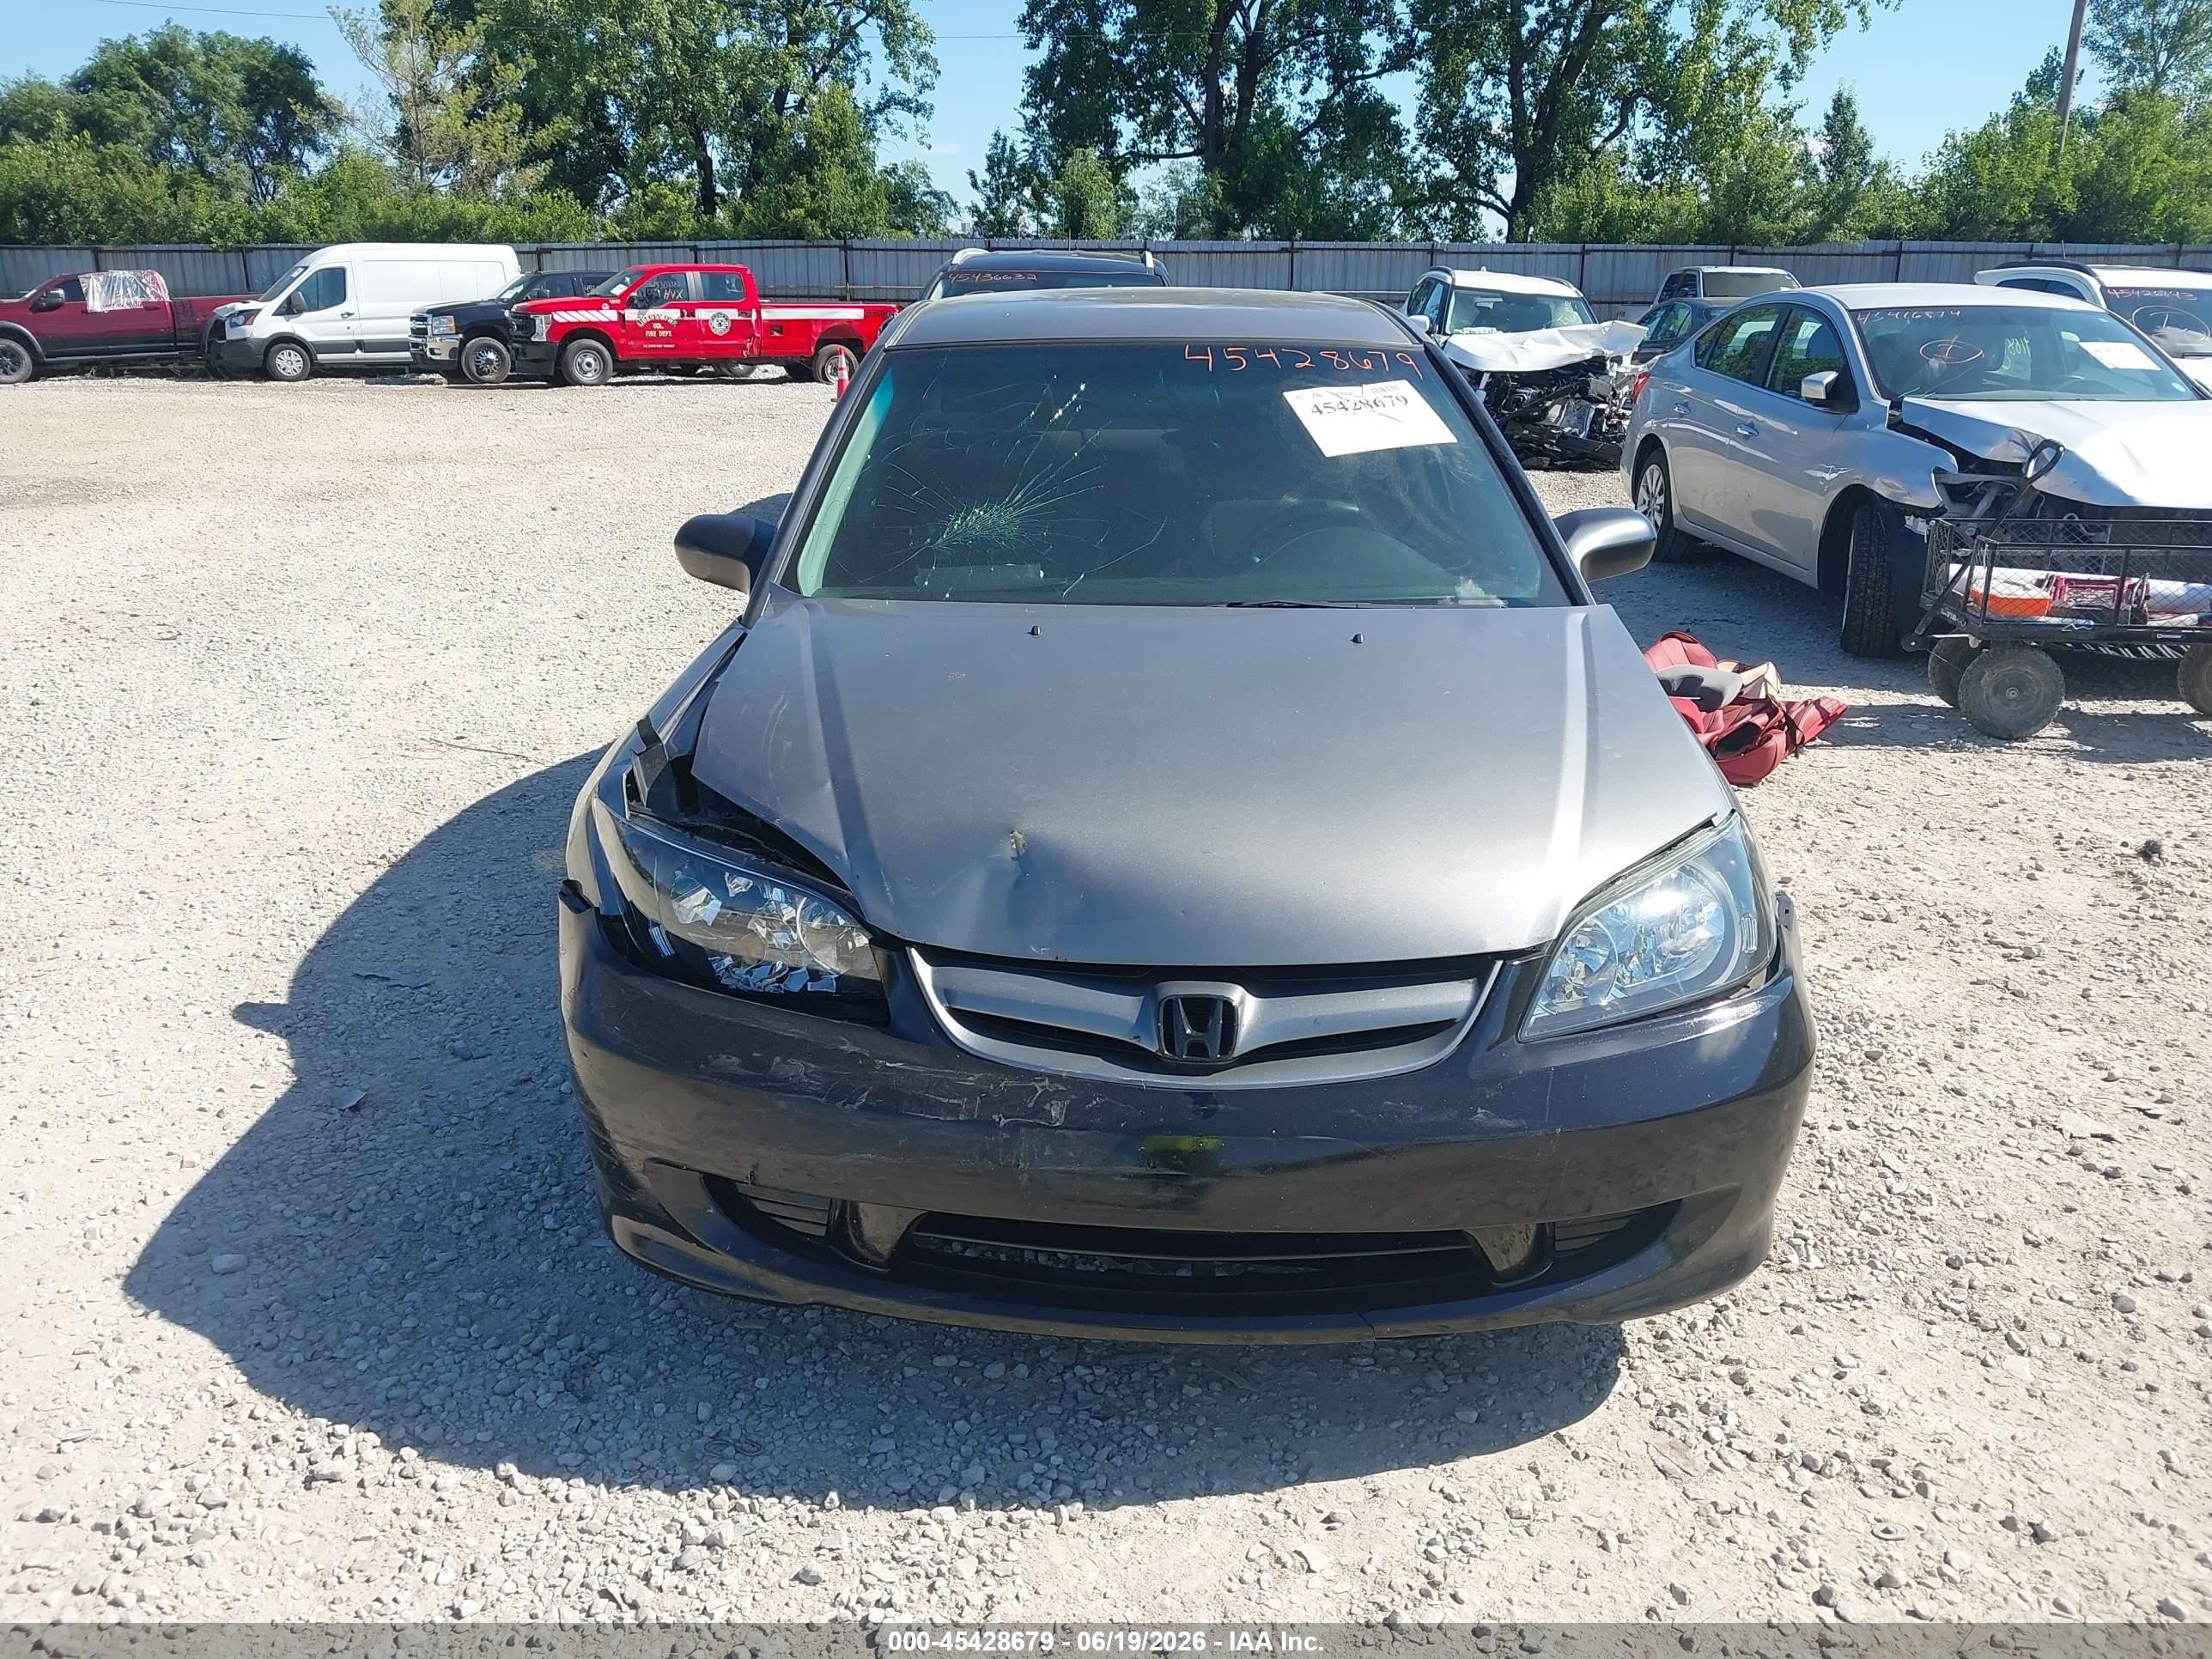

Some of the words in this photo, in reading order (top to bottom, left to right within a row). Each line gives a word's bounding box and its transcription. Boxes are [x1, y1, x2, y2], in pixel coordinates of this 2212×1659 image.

[948, 273, 1037, 283] 45436632
[1184, 343, 1424, 380] 45428679
[1310, 394, 1408, 416] 45428679
